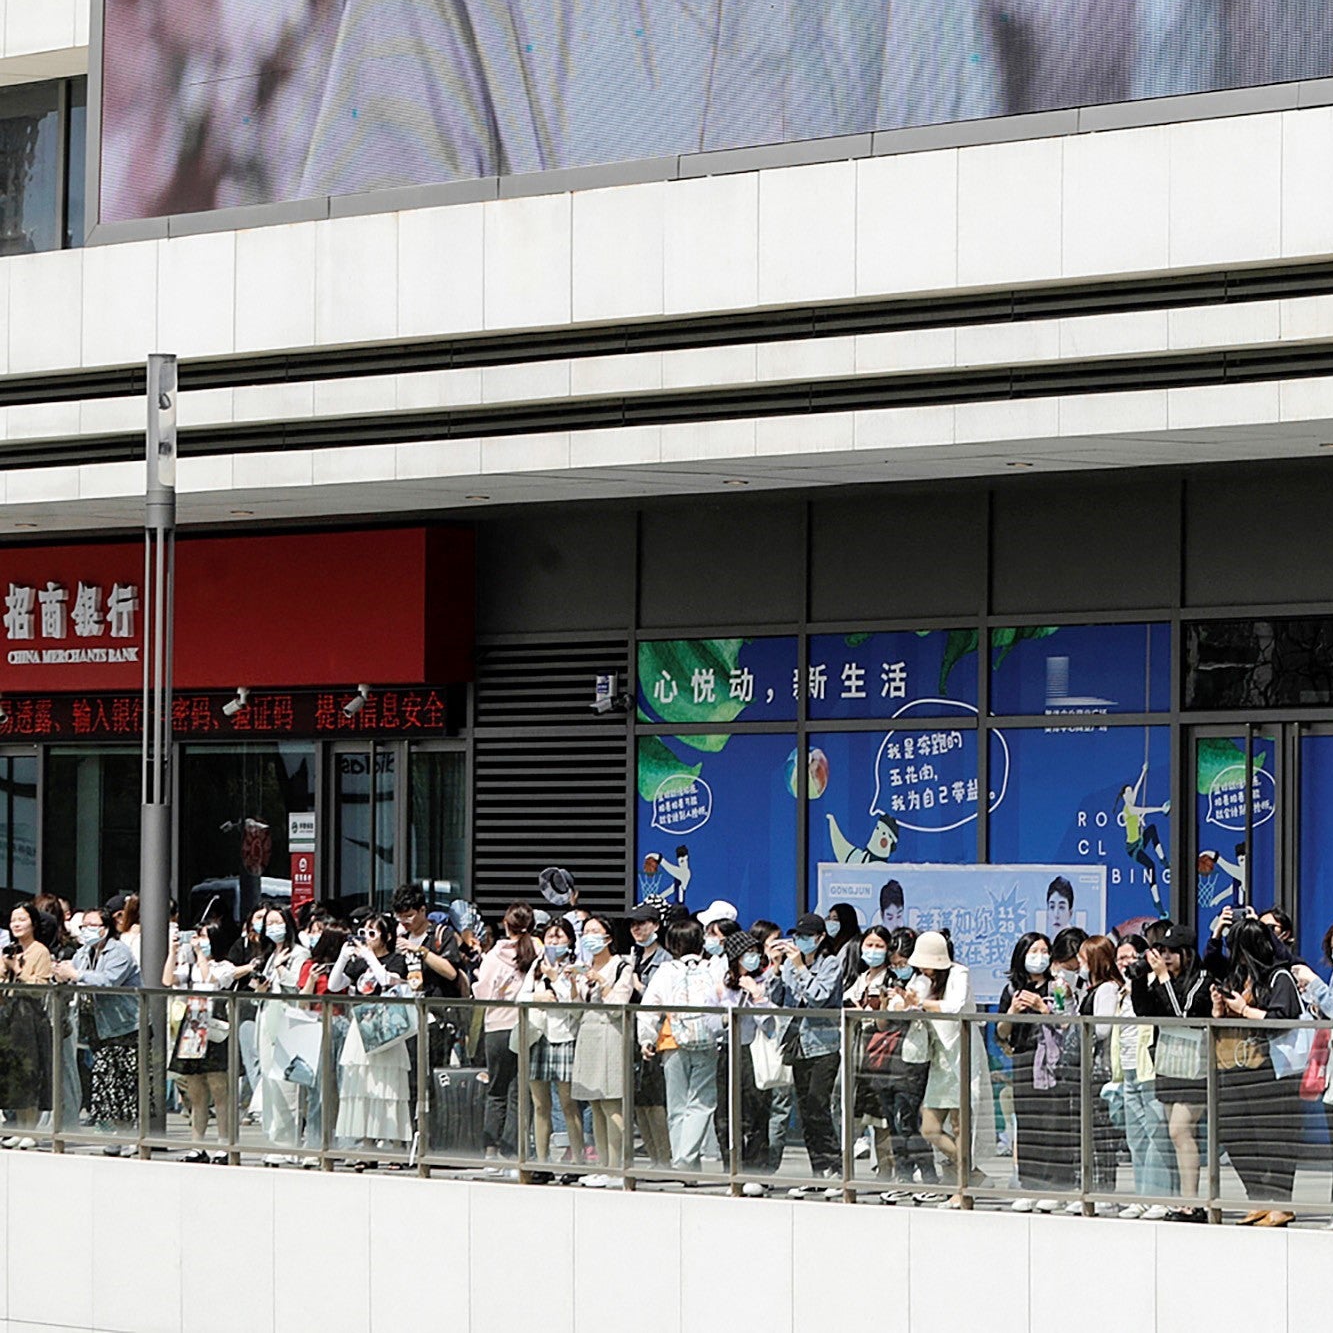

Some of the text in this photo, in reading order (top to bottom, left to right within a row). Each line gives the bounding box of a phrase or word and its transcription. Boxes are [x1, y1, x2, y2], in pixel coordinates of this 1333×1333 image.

[3, 580, 139, 639] 招商银行
[7, 648, 139, 664] CHINA MERCHANTS BANK
[887, 730, 962, 759] 我是奔跑的
[999, 906, 1015, 919] 11
